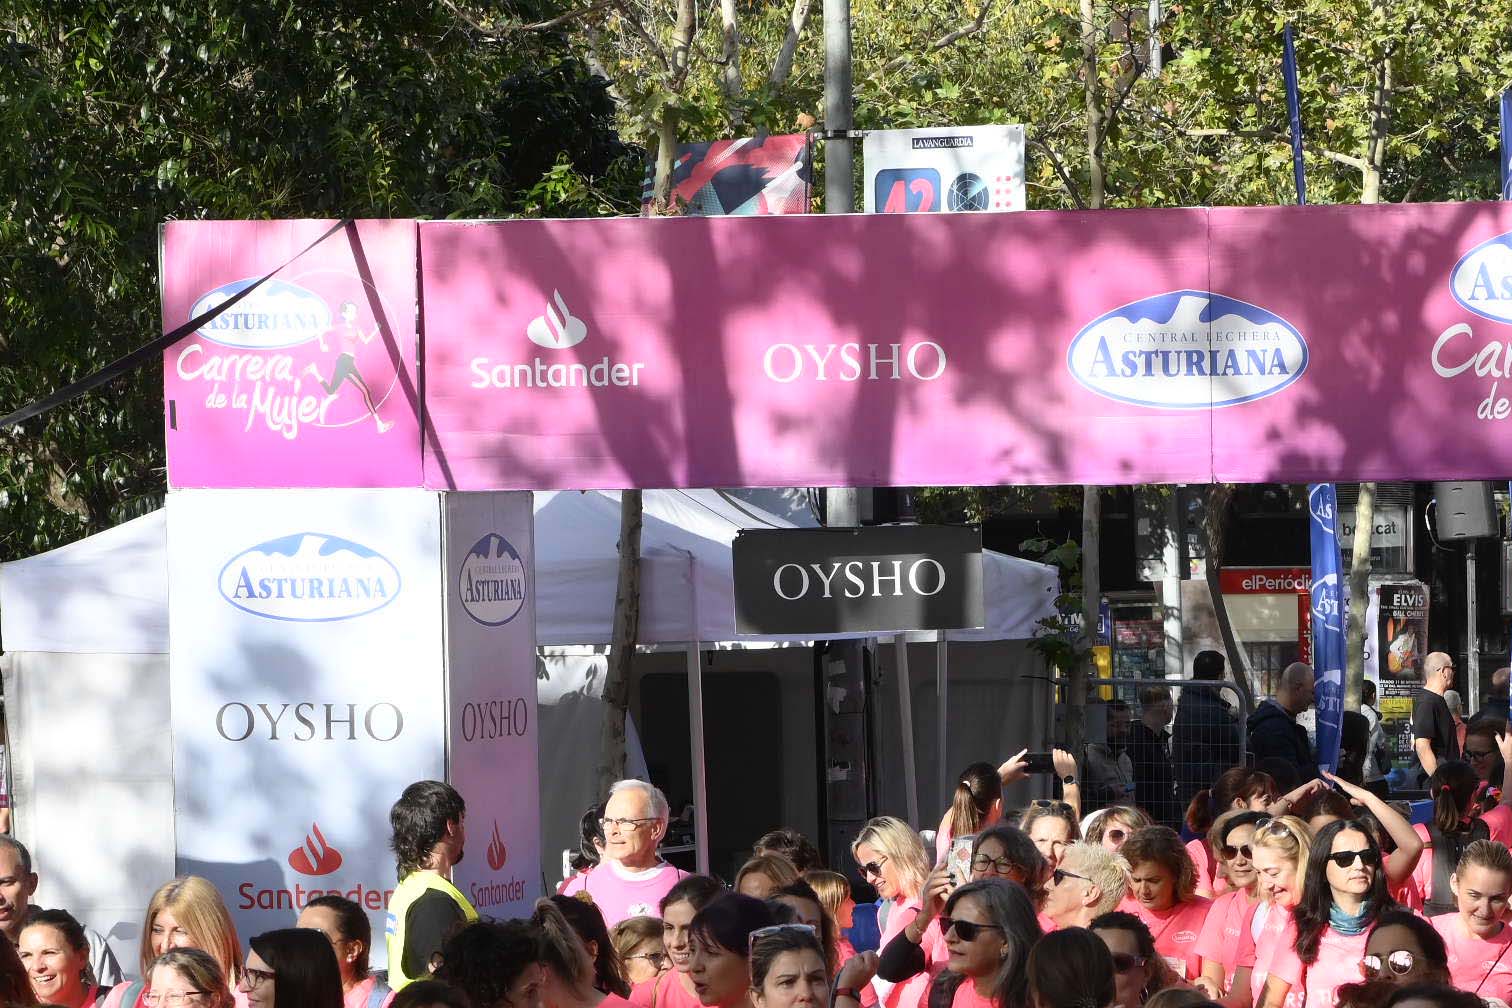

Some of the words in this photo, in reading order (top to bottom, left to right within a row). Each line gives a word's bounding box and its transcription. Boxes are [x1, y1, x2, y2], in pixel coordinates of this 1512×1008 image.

[922, 137, 972, 148] VANGUARDIA
[1123, 331, 1198, 343] CENTRAL
[1206, 330, 1281, 343] LECHERA
[176, 344, 293, 381] Carrera
[470, 356, 645, 388] Santander
[763, 341, 947, 383] OYSHO
[1089, 335, 1290, 378] ASTURIANA
[206, 384, 227, 409] de
[232, 385, 248, 409] la
[245, 378, 338, 440] Mujer
[1477, 381, 1511, 420] de
[232, 566, 389, 600] ASTURIANA
[465, 567, 523, 603] ASTURIANA
[773, 558, 946, 601] OYSHO
[1393, 593, 1425, 606] ELVIS
[216, 702, 404, 742] OYSHO
[461, 697, 528, 742] OYSHO
[470, 877, 526, 909] Santander
